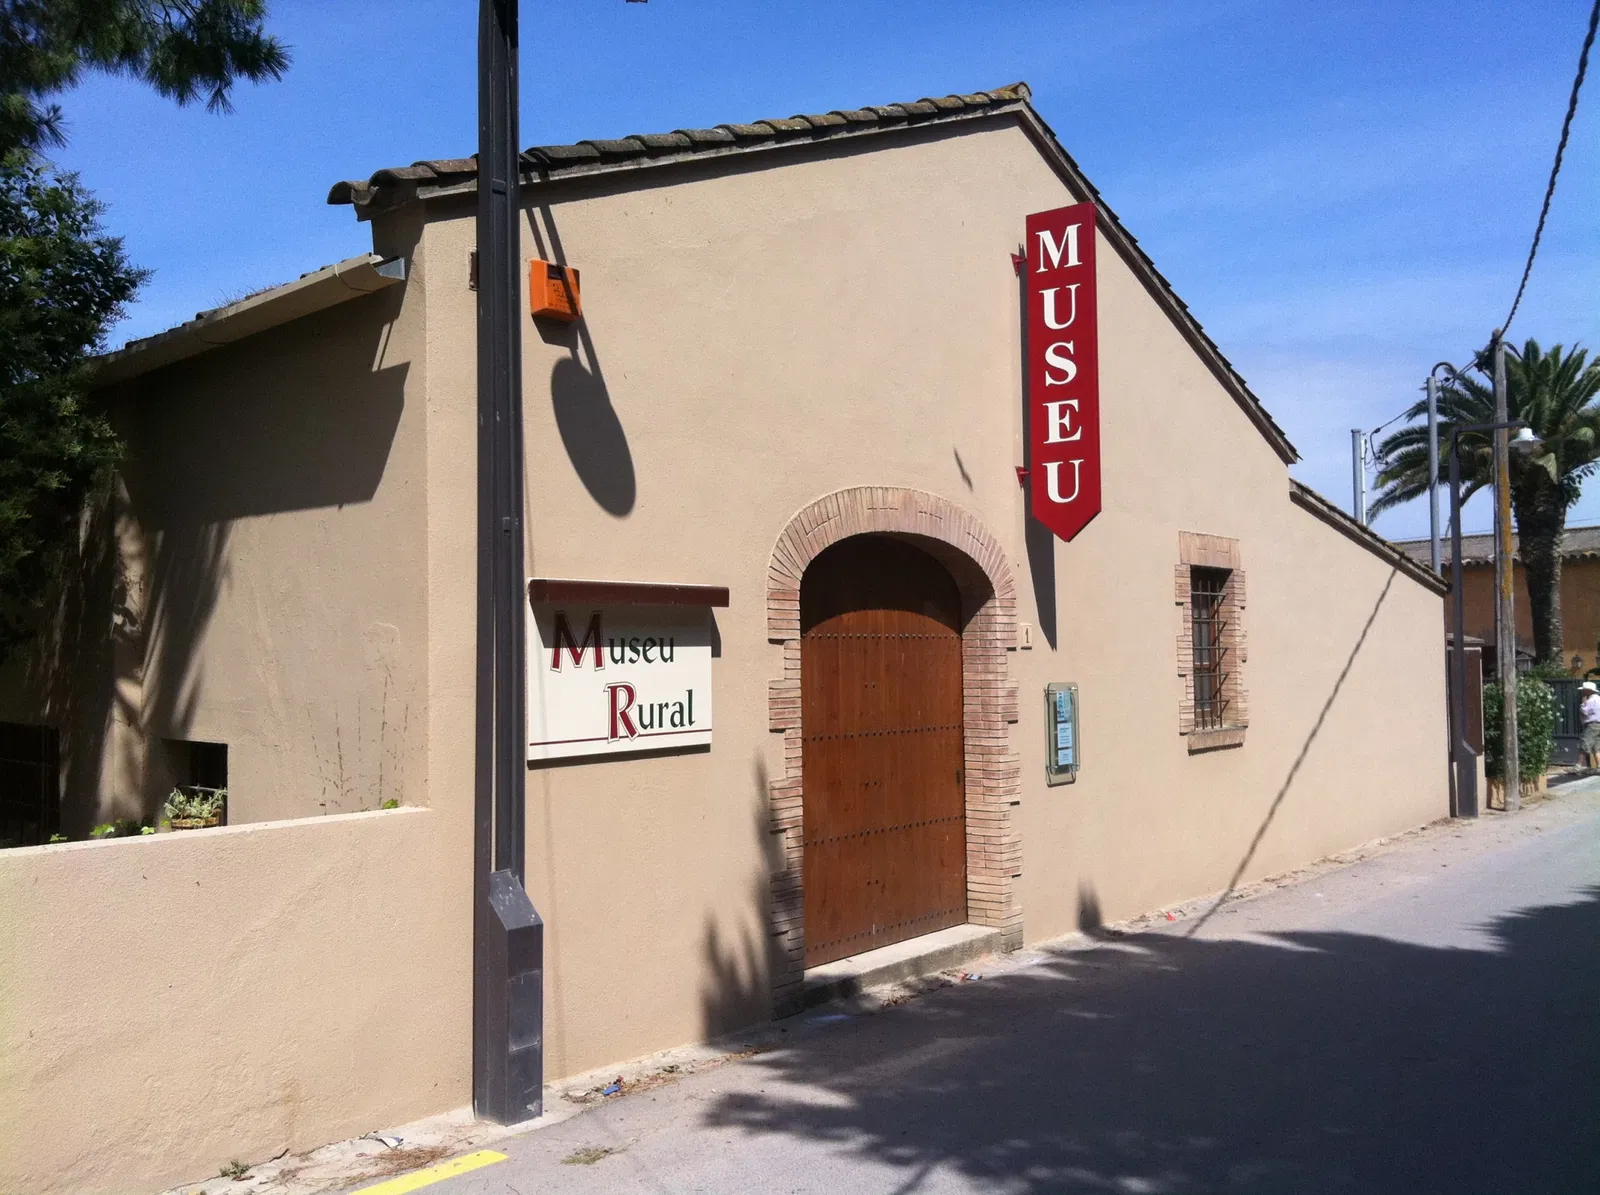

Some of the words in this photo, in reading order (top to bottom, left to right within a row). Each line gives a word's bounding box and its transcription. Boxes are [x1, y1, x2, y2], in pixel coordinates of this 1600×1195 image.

[1035, 223, 1083, 503] MUSEU
[550, 610, 674, 673] Museu
[1024, 628, 1030, 643] 1
[603, 681, 695, 744] Rural
